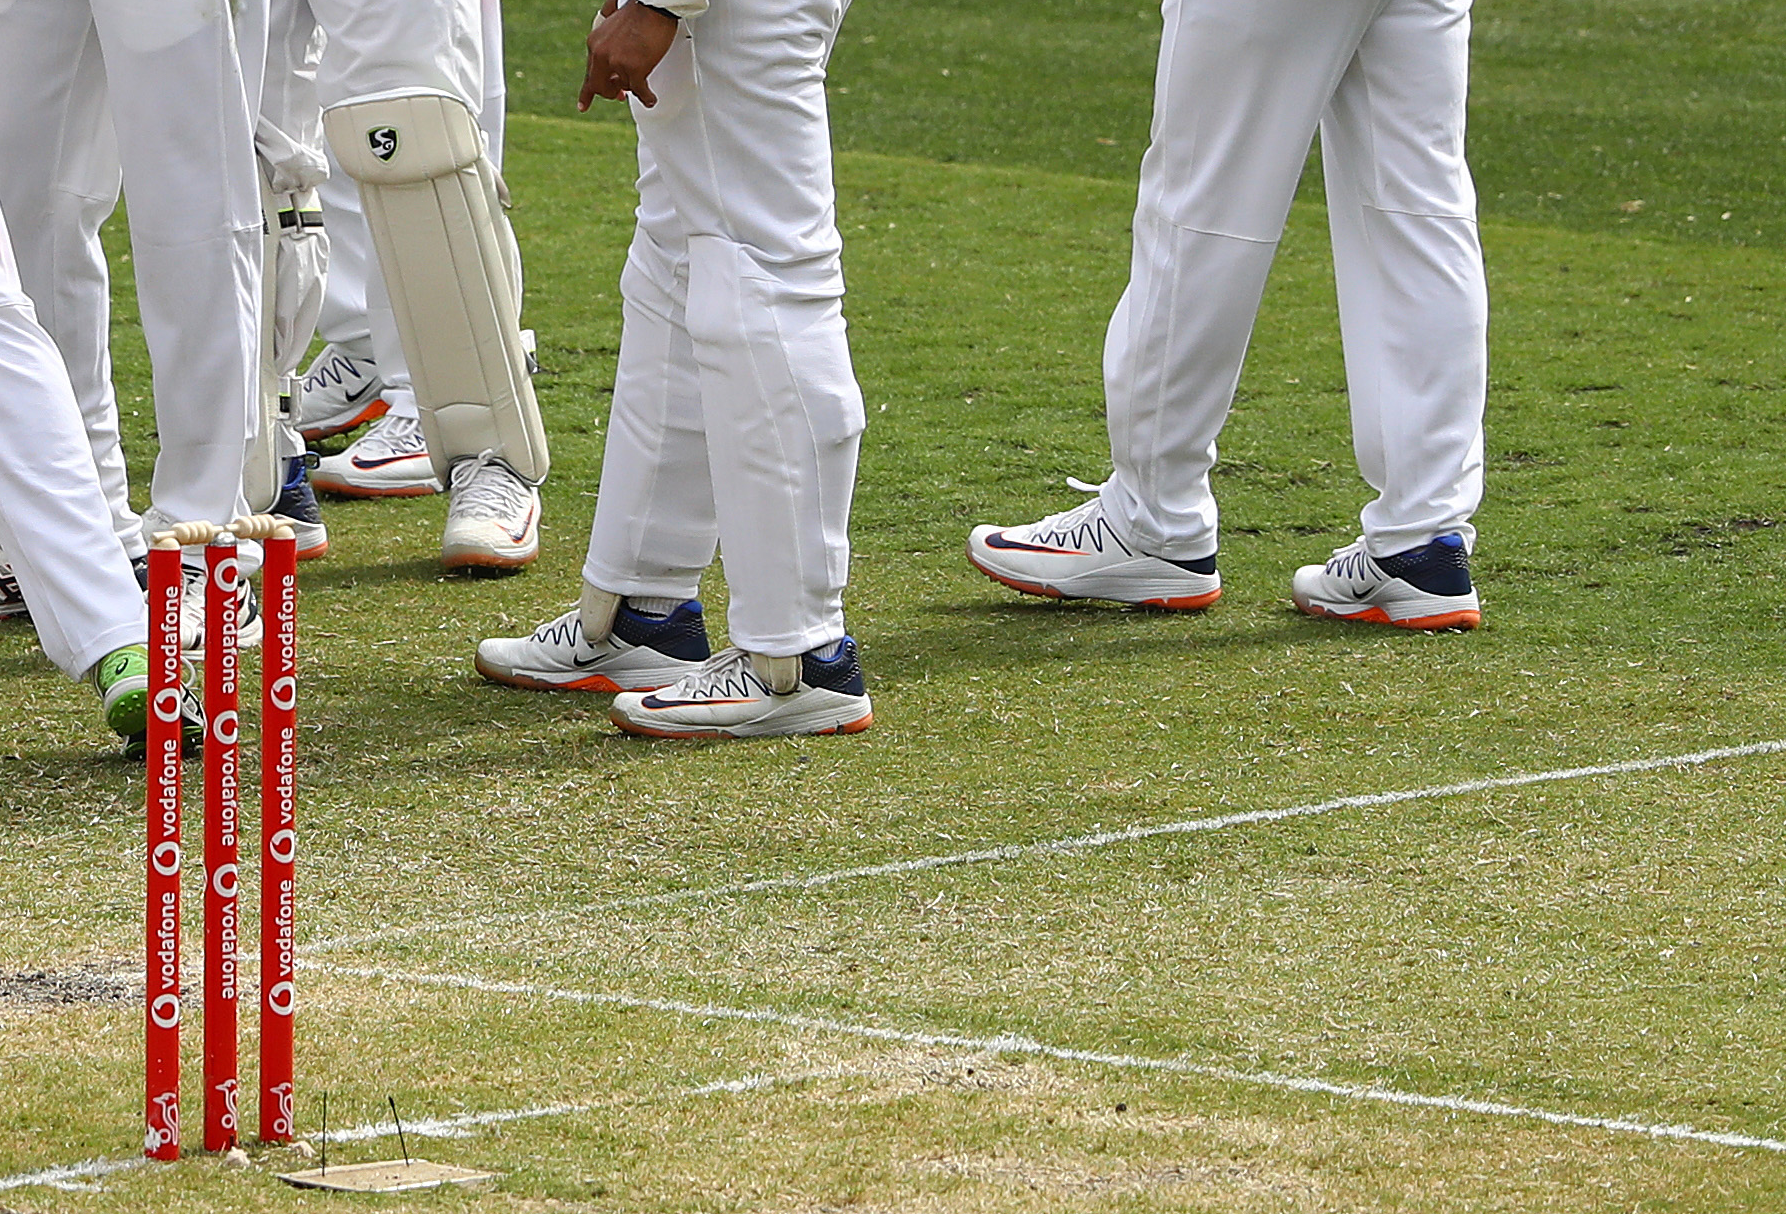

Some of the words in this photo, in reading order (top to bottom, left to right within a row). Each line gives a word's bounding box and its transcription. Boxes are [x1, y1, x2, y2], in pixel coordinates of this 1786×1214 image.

[160, 585, 179, 684] vodafone
[222, 596, 238, 694] vodafone
[277, 574, 295, 672] vodafone
[159, 738, 177, 837] vodafone
[221, 748, 237, 847] vodafone
[276, 727, 294, 825] vodafone
[157, 890, 176, 990] vodafone
[221, 902, 236, 1000] vodafone
[275, 878, 292, 976] vodafone
